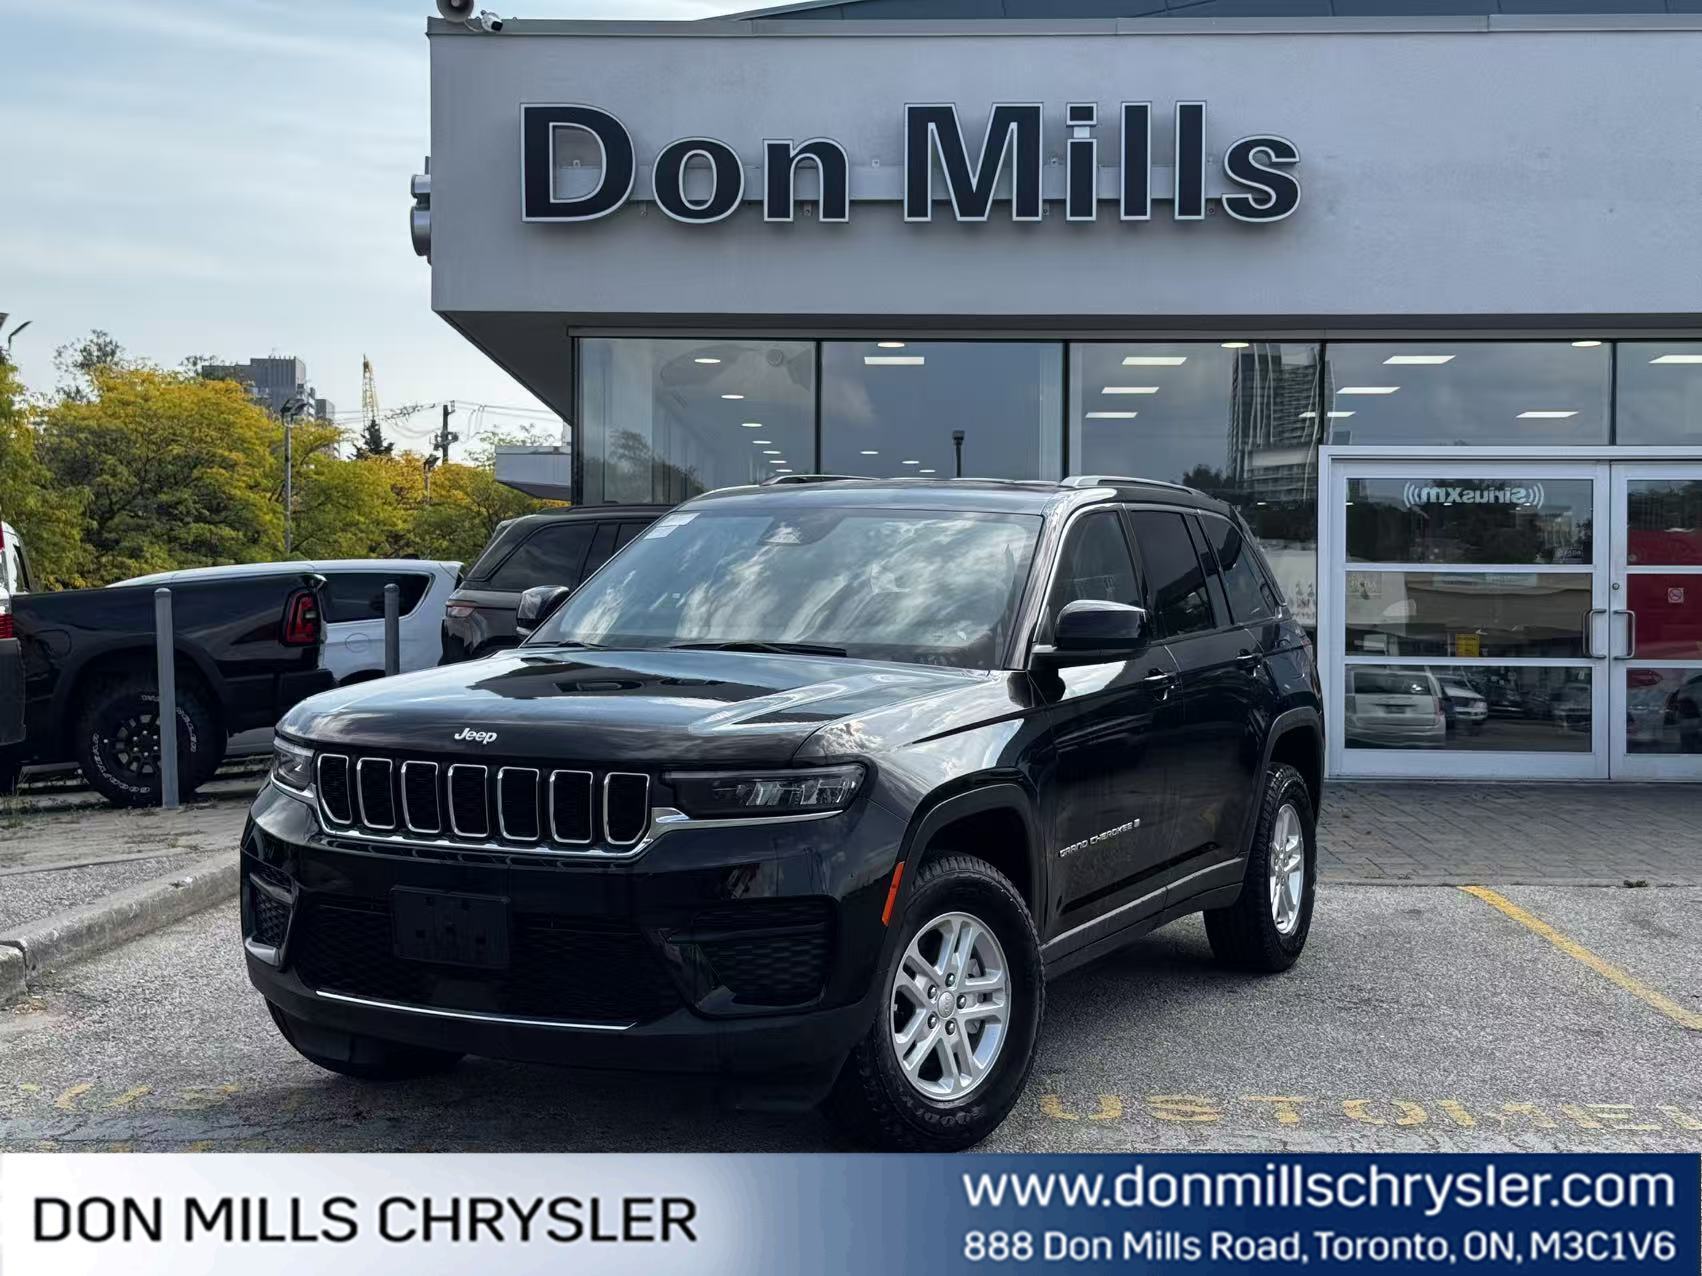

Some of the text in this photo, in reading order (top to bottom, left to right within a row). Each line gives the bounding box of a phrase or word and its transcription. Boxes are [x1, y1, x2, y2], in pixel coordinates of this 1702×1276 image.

[520, 101, 1302, 224] Don Mills
[454, 728, 497, 744] Jeep
[1059, 821, 1133, 857] GRAND CHEROKEE
